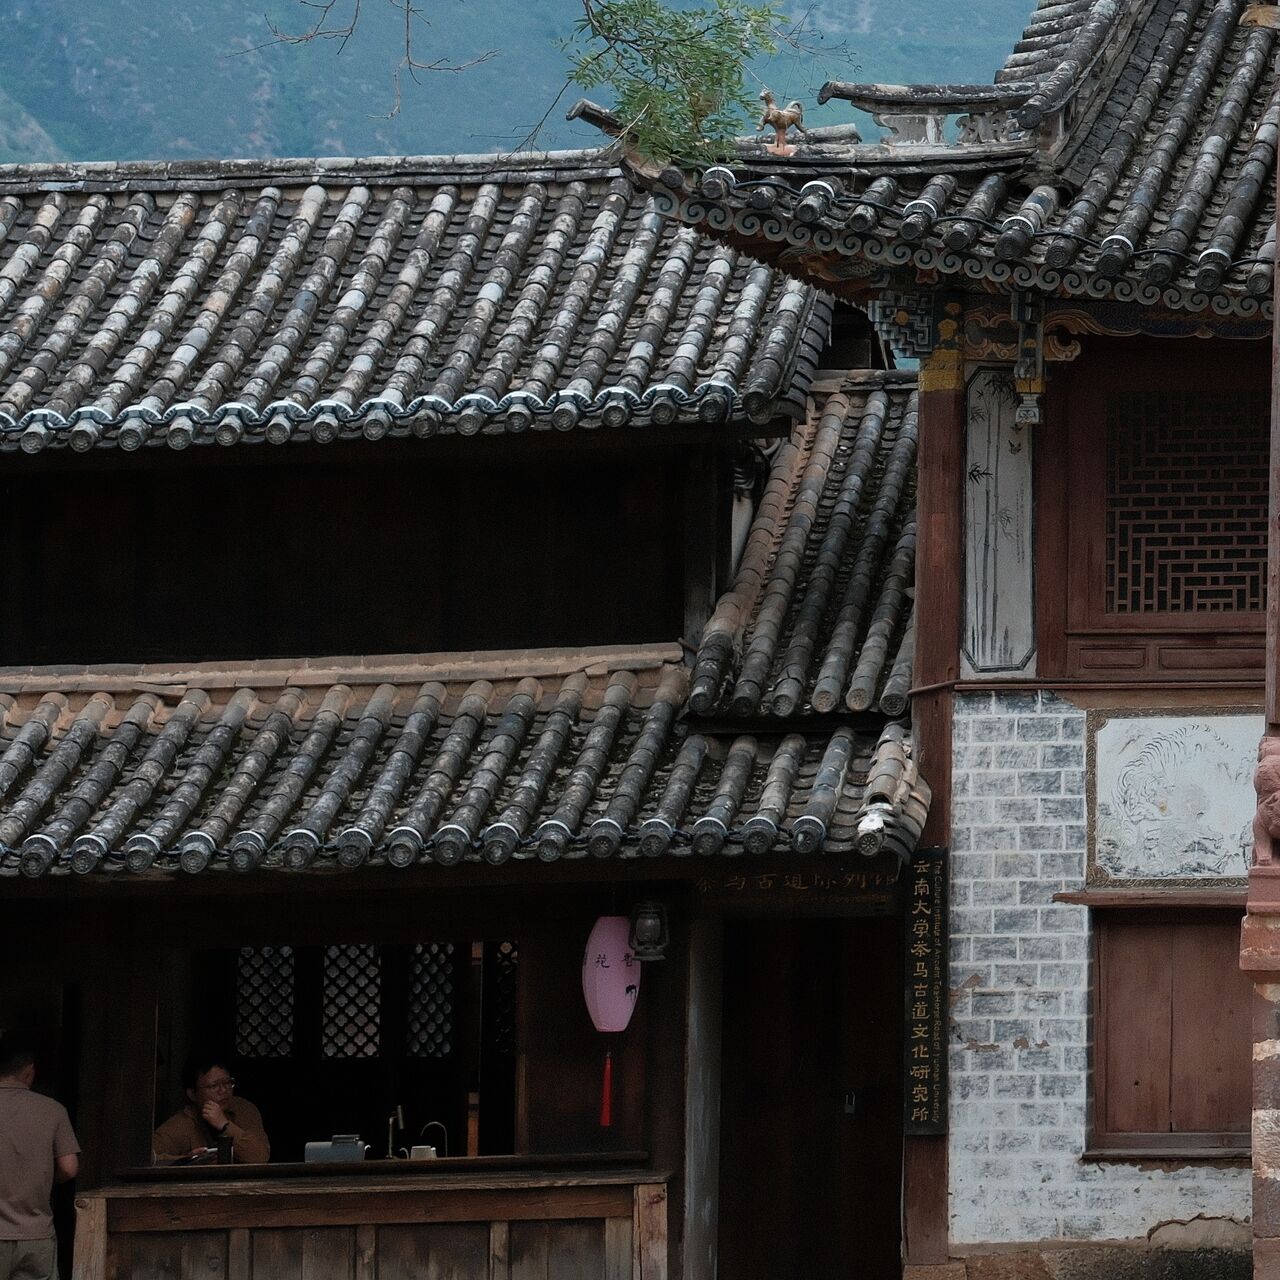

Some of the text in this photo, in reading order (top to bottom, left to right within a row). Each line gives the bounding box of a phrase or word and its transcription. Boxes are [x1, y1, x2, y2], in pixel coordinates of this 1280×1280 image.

[934, 859, 943, 875] The
[934, 876, 943, 904] Culture
[933, 949, 942, 978] Ancient
[909, 859, 932, 1122] 云南大学茶马古道文化研究所
[931, 1084, 941, 1123] University
